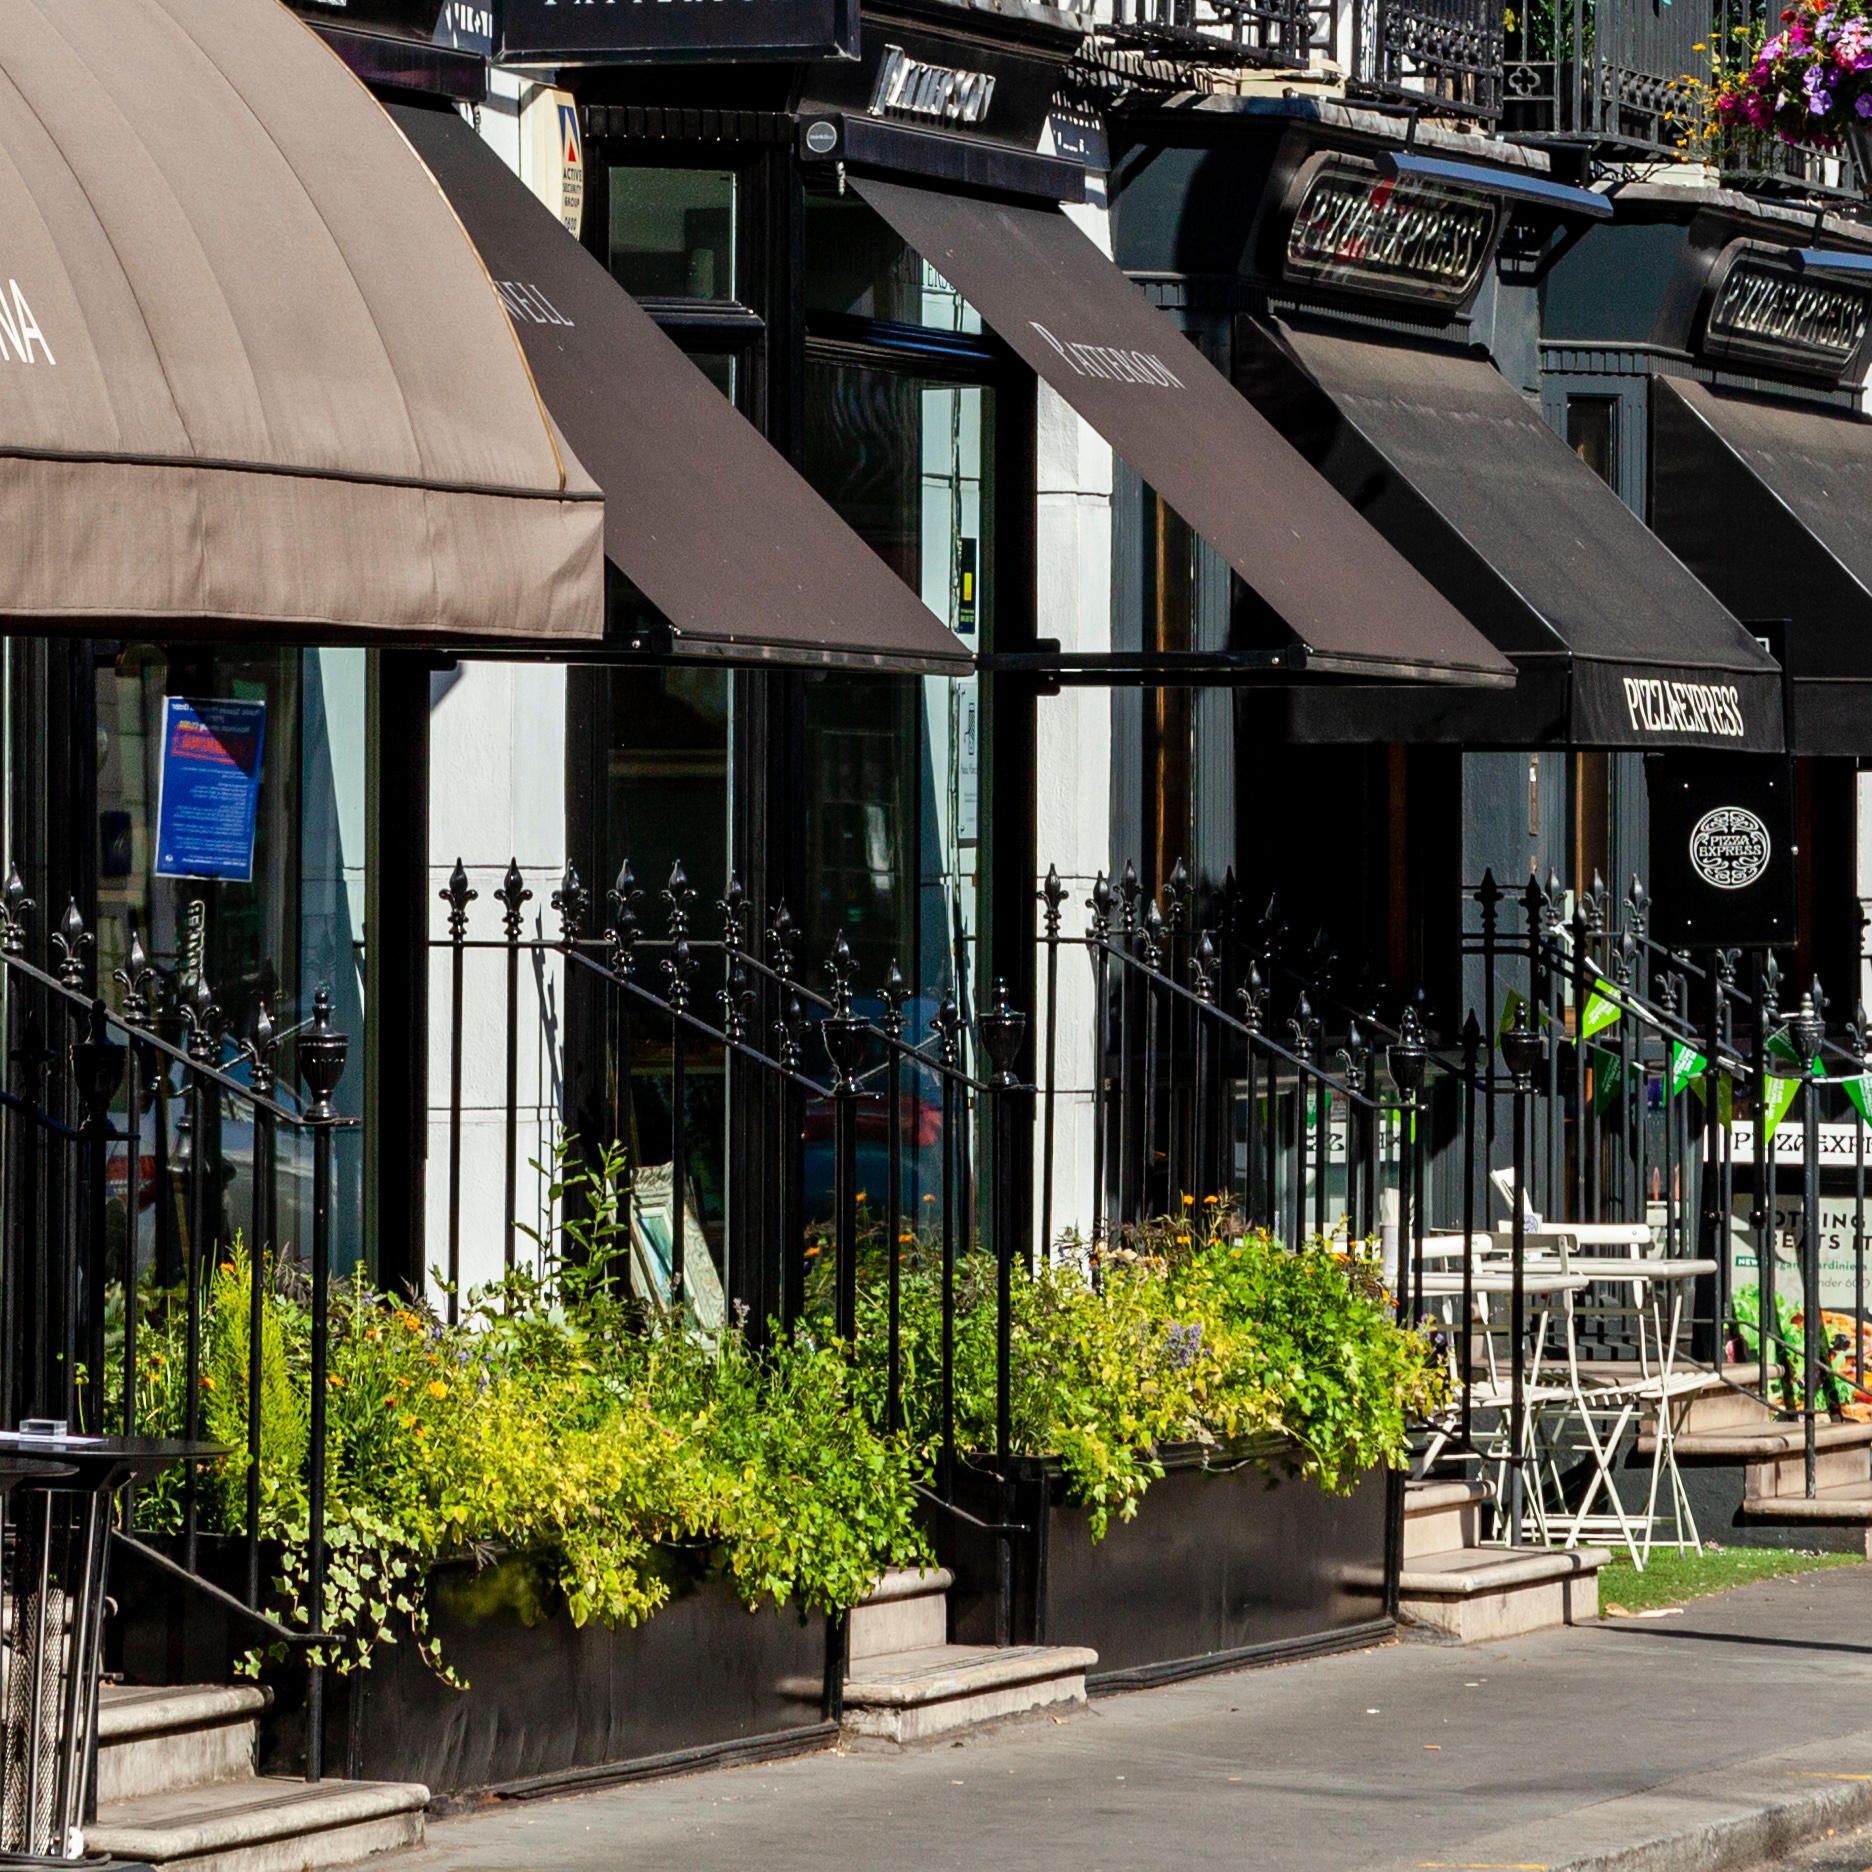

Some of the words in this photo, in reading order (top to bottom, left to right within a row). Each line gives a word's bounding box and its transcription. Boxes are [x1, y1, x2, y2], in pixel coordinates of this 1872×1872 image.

[564, 197, 580, 208] GROUP
[1028, 320, 1187, 391] PATTERSON
[1709, 835, 1749, 847] PIZZA
[1698, 845, 1761, 857] EXPRESS
